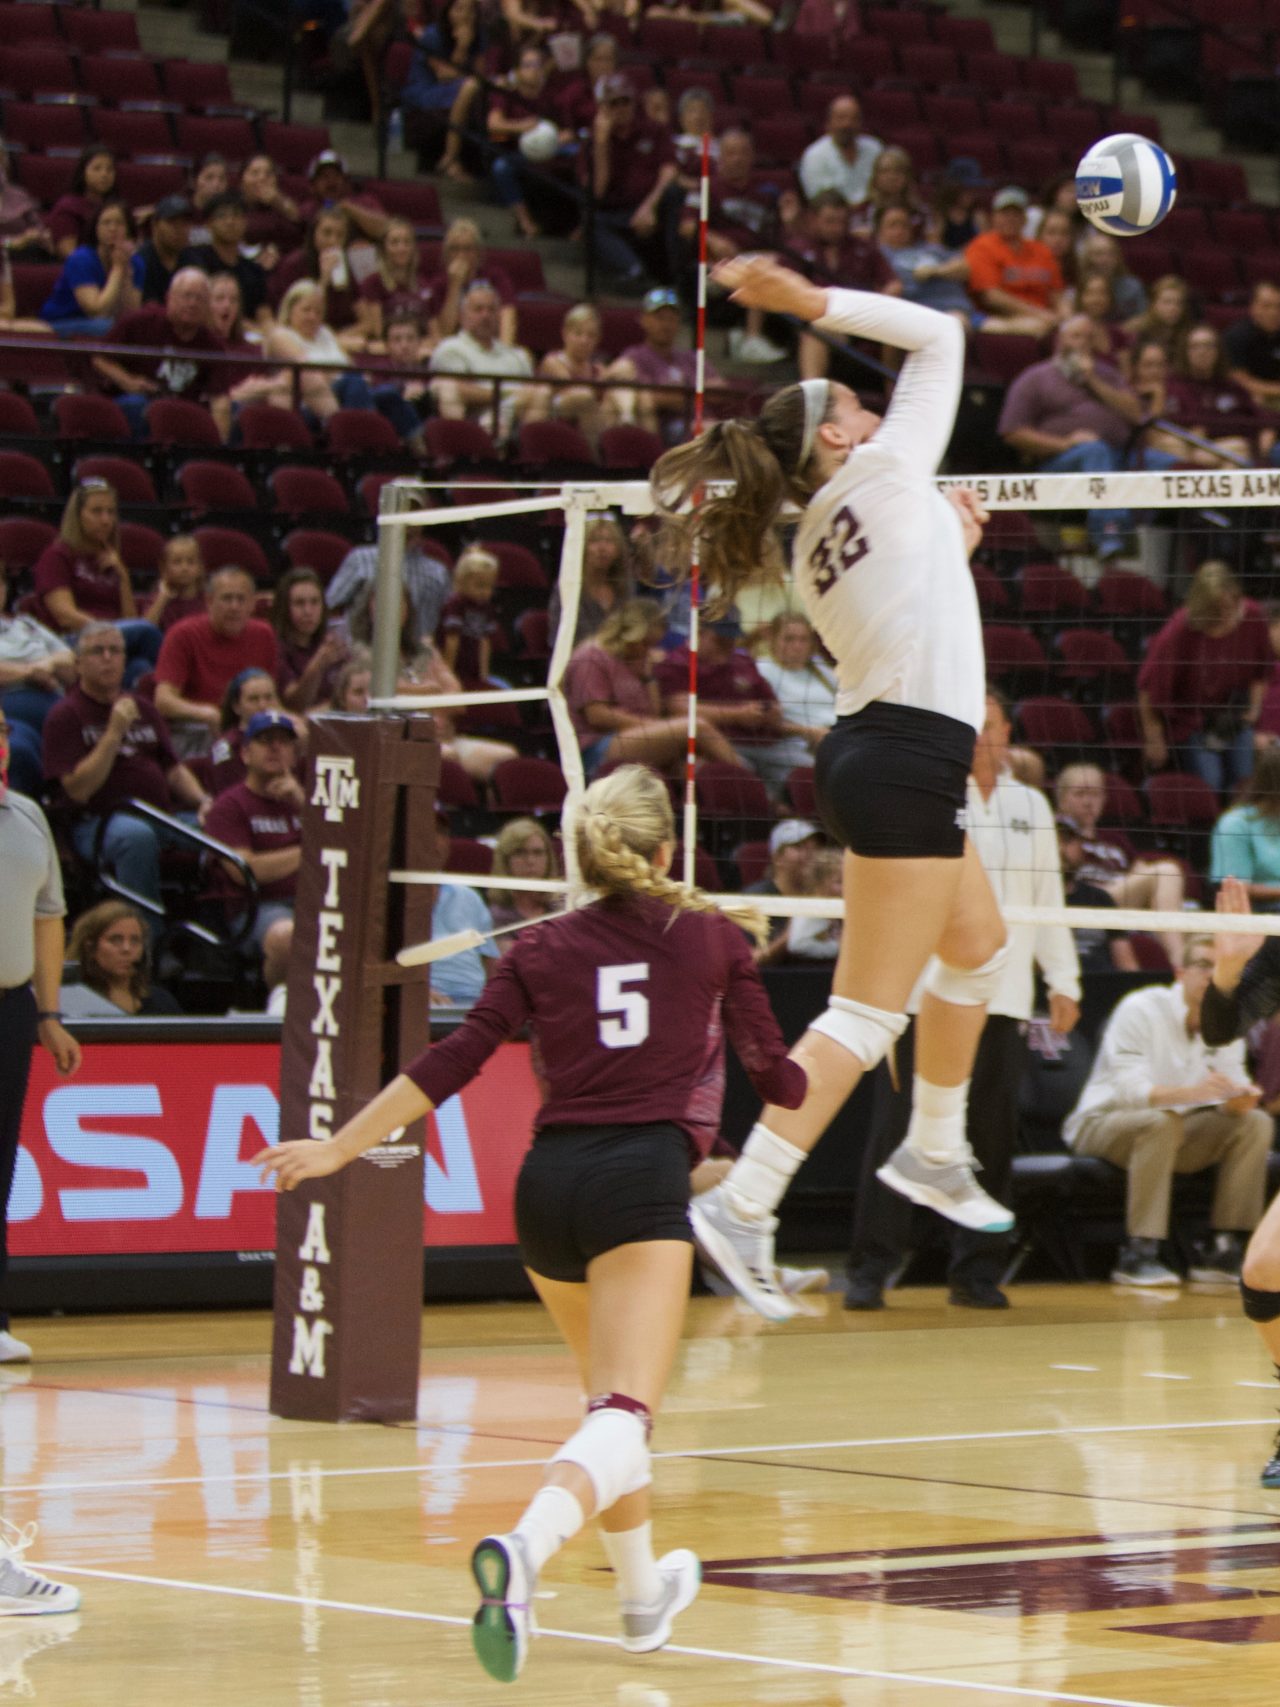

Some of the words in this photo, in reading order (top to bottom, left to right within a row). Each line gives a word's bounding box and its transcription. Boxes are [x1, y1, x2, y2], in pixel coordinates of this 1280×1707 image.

[997, 479, 1039, 501] A&M
[1162, 474, 1232, 499] TEXAS
[809, 505, 871, 598] 32
[597, 962, 649, 1050] 5
